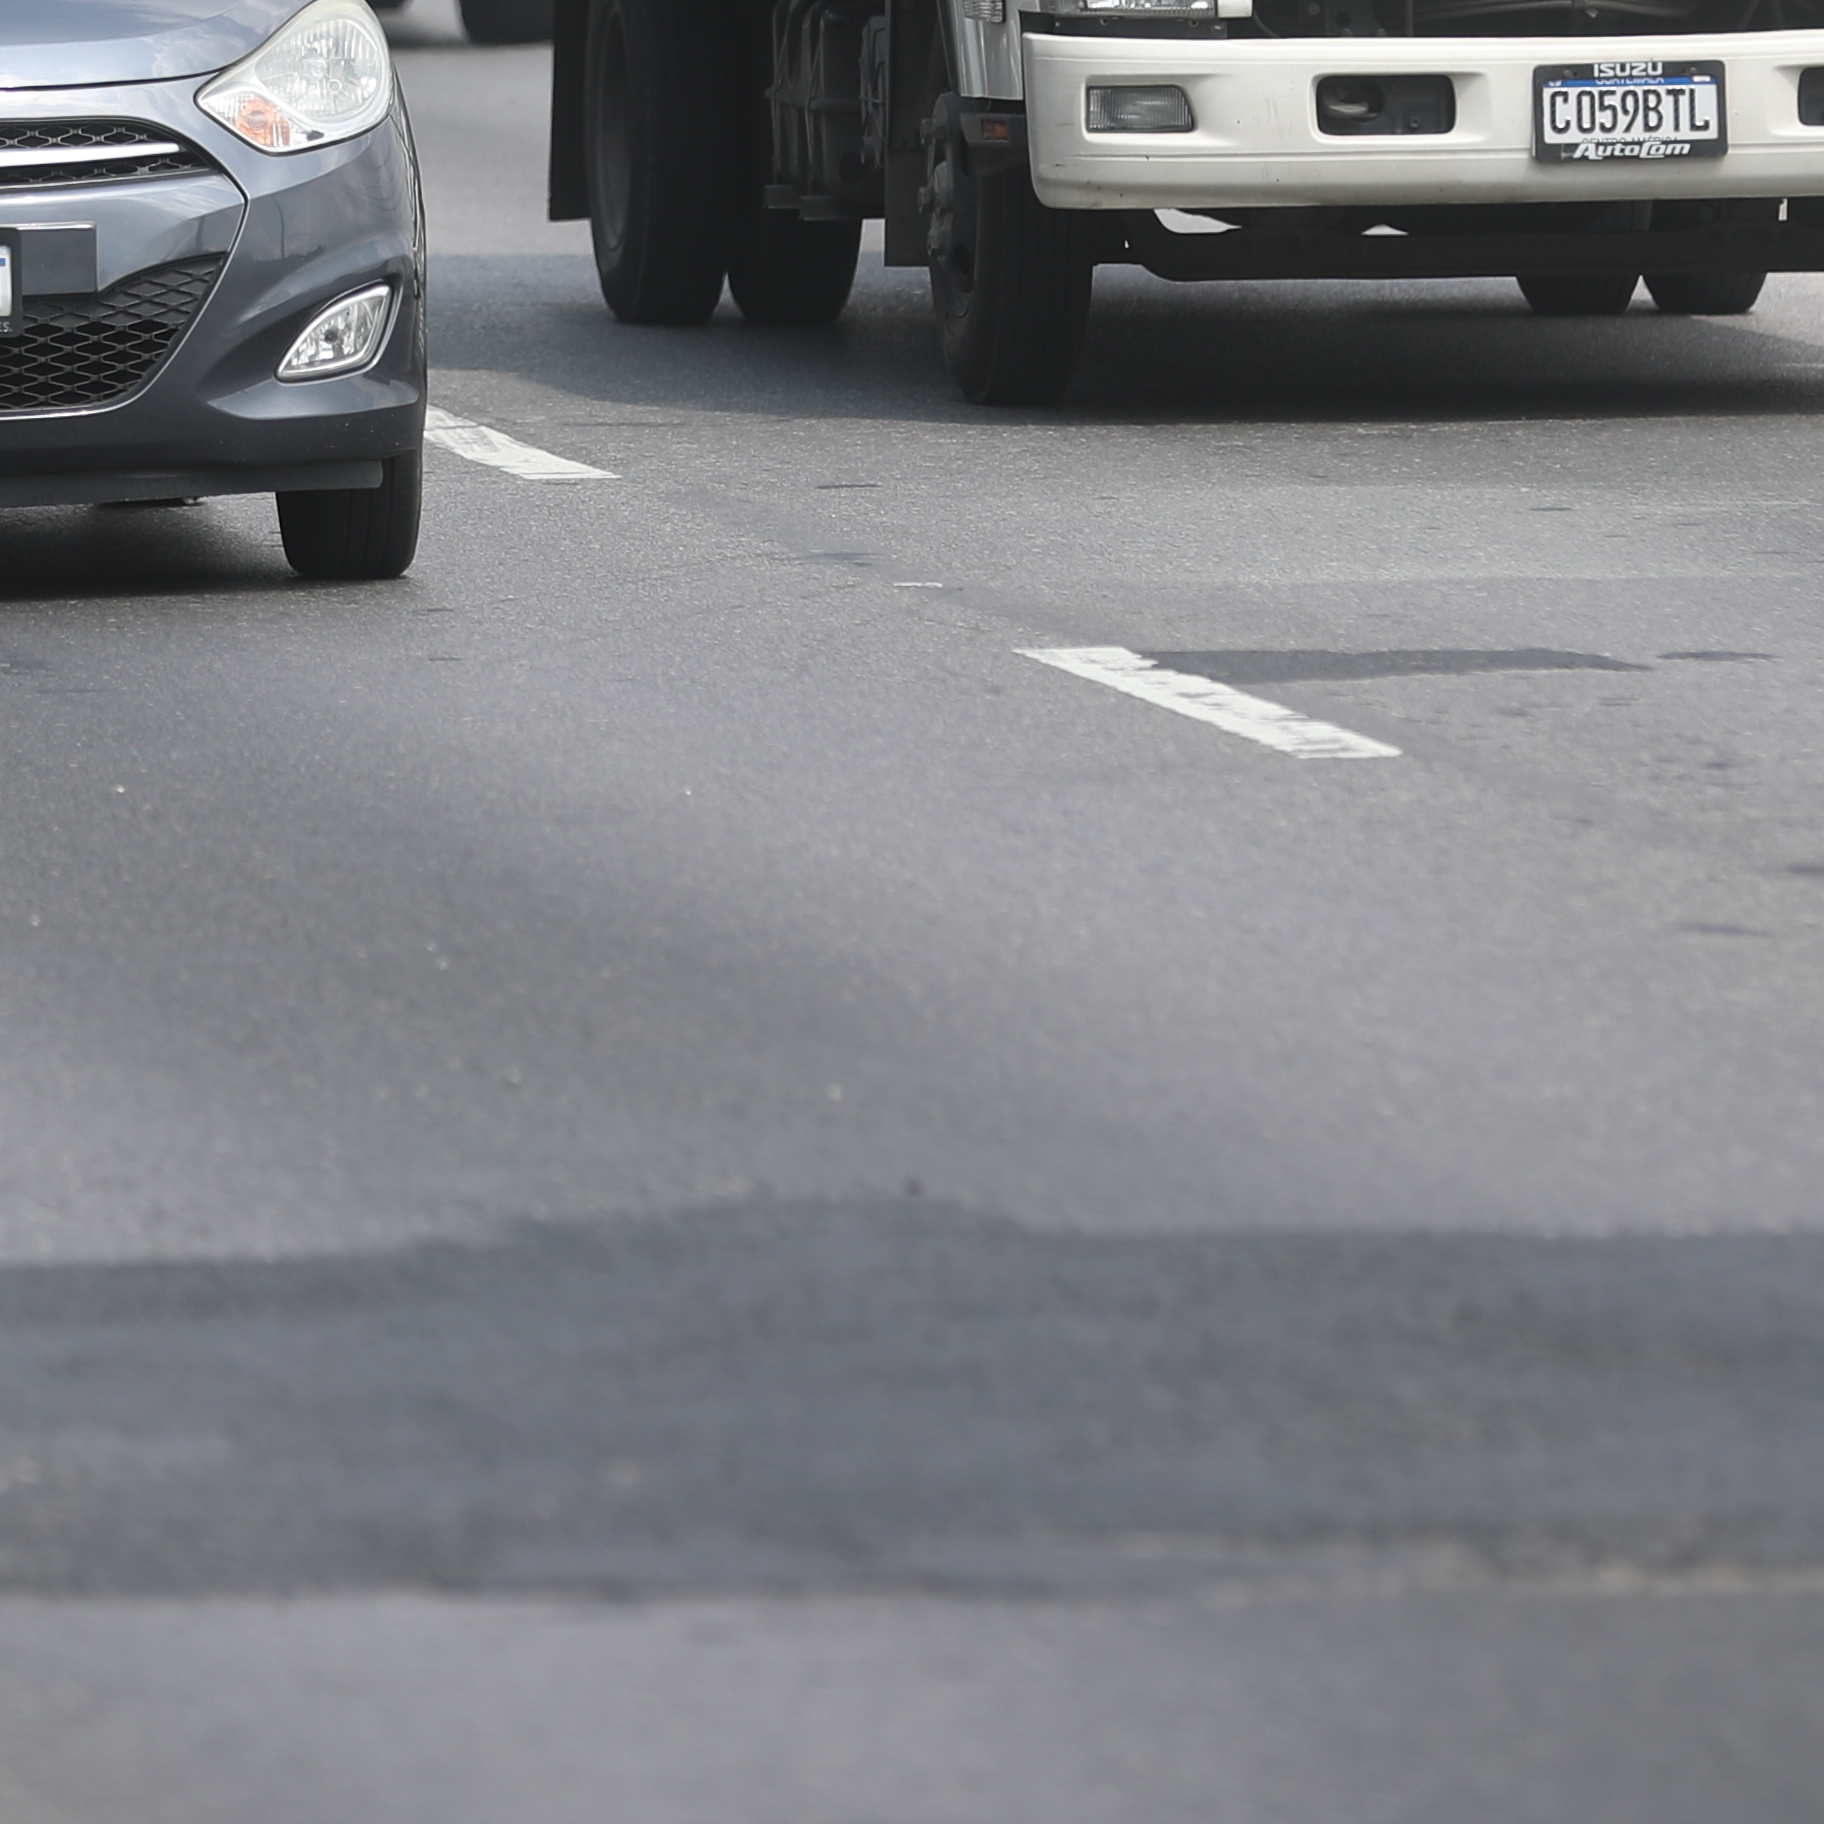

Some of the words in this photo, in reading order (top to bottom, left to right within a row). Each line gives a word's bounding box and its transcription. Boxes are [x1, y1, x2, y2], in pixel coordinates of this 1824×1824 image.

[1594, 62, 1663, 77] ISUZU
[1549, 86, 1710, 134] C059BTL
[1573, 142, 1691, 160] AutoCom
